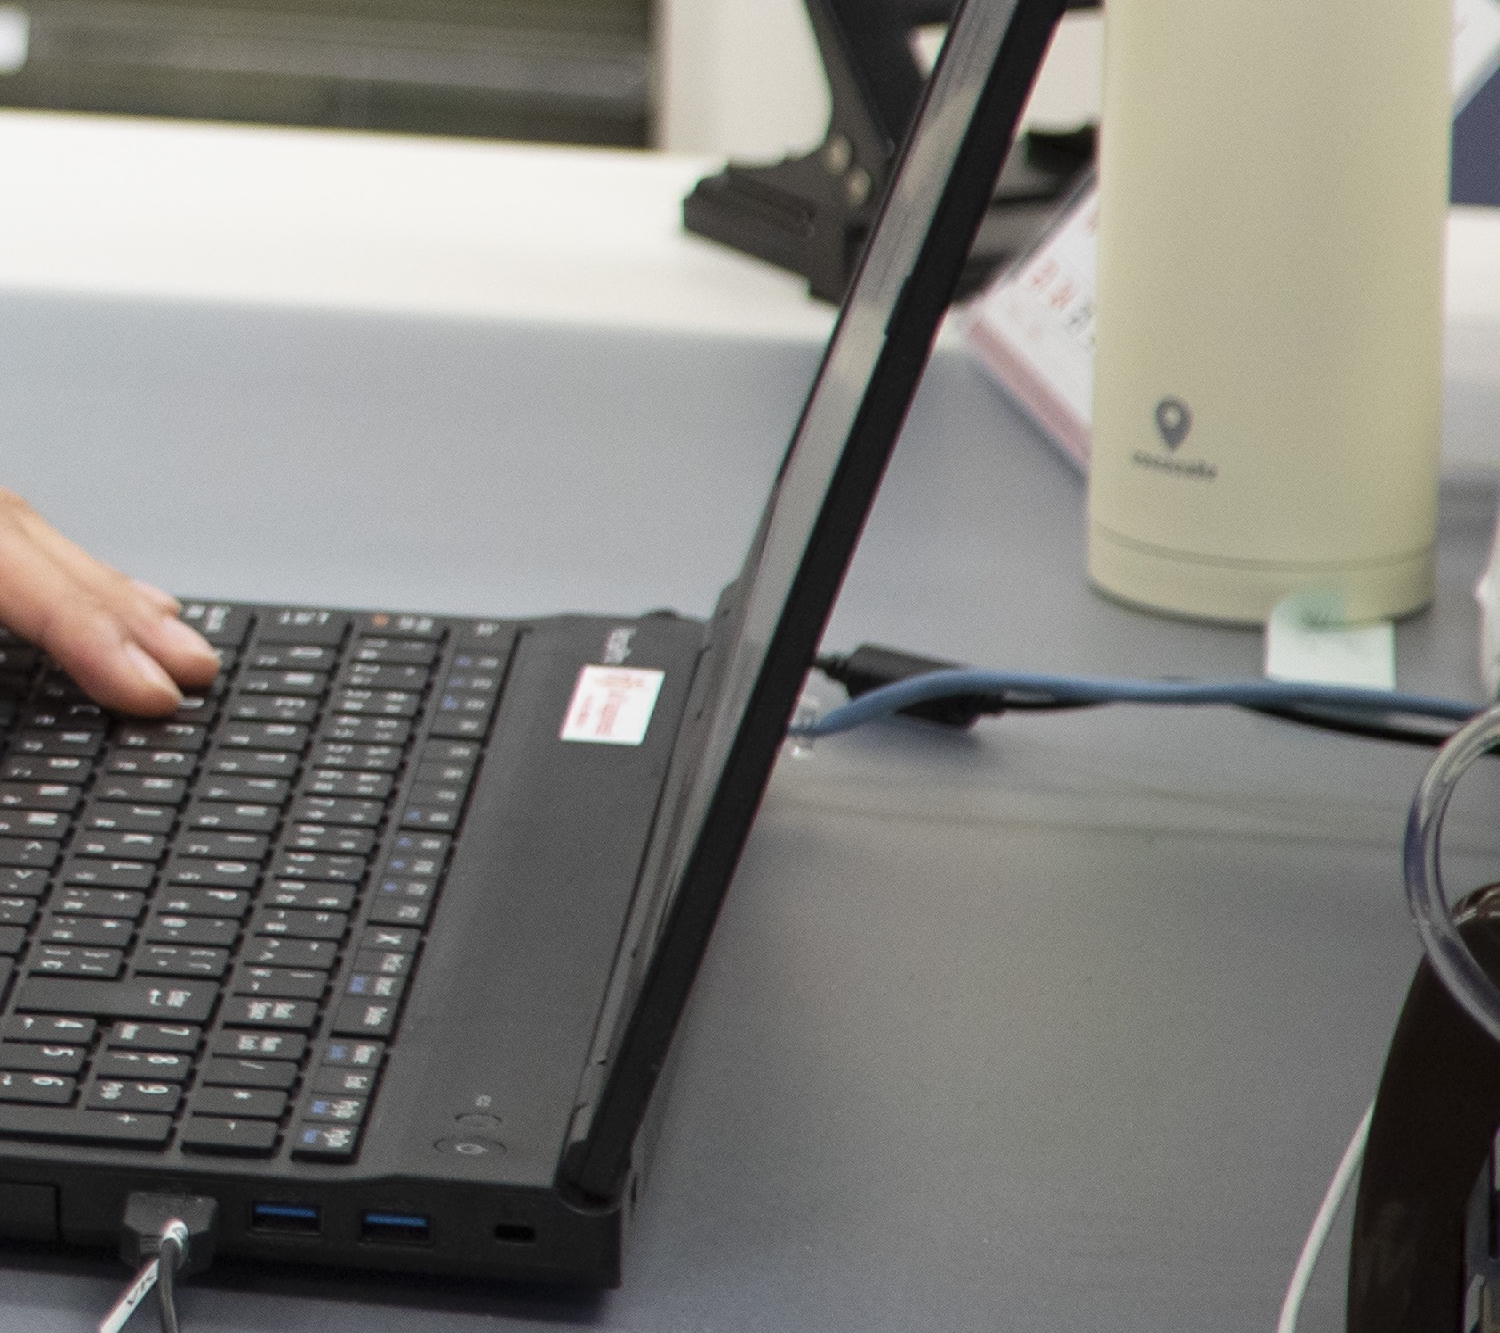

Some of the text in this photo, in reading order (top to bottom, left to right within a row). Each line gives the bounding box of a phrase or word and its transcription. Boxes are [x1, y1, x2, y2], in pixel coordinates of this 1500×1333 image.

[55, 1019, 83, 1028] 4
[160, 1027, 190, 1036] 7
[42, 1048, 74, 1056] 5
[148, 1055, 178, 1064] 8
[33, 1077, 63, 1086] 6
[137, 1085, 168, 1094] 9
